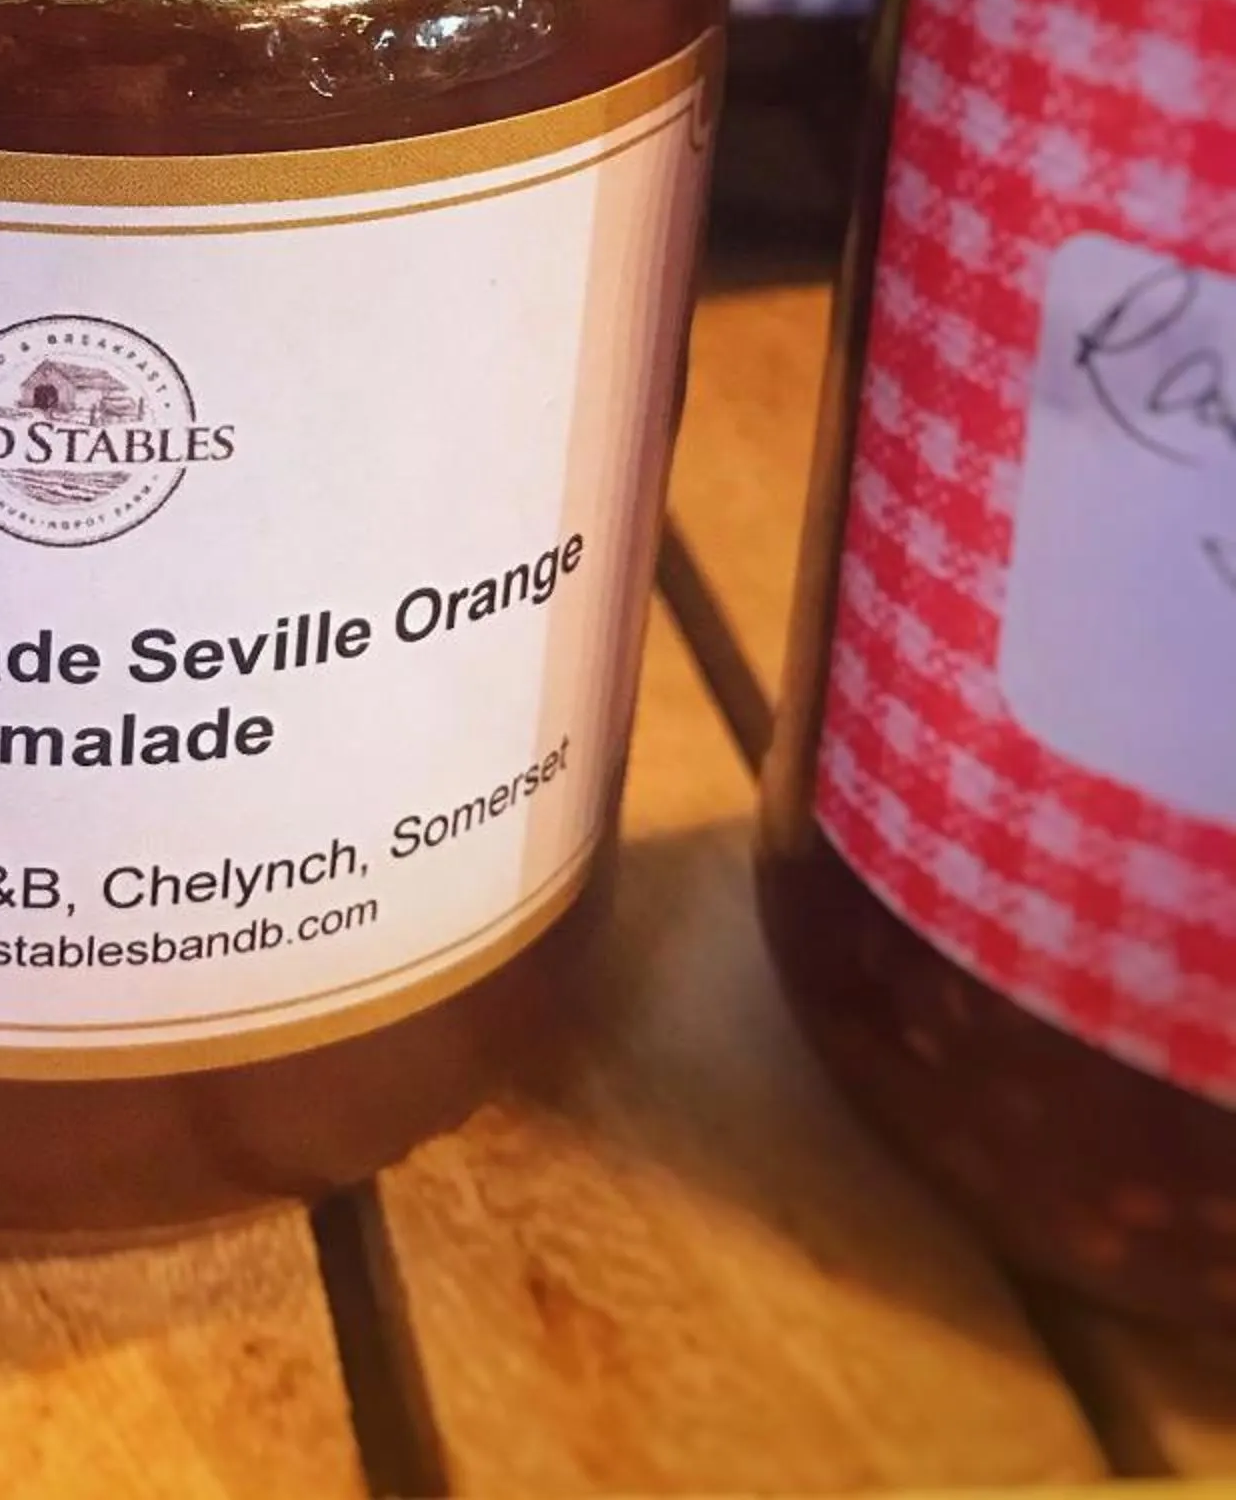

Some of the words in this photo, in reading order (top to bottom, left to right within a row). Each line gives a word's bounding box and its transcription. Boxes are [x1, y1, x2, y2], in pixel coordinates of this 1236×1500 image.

[46, 333, 168, 393] BREAKFAST
[24, 421, 236, 464] STABLES
[128, 610, 372, 684] Seville
[394, 531, 584, 645] Orange
[102, 838, 370, 910] Chelynch,
[389, 736, 570, 860] Somerset
